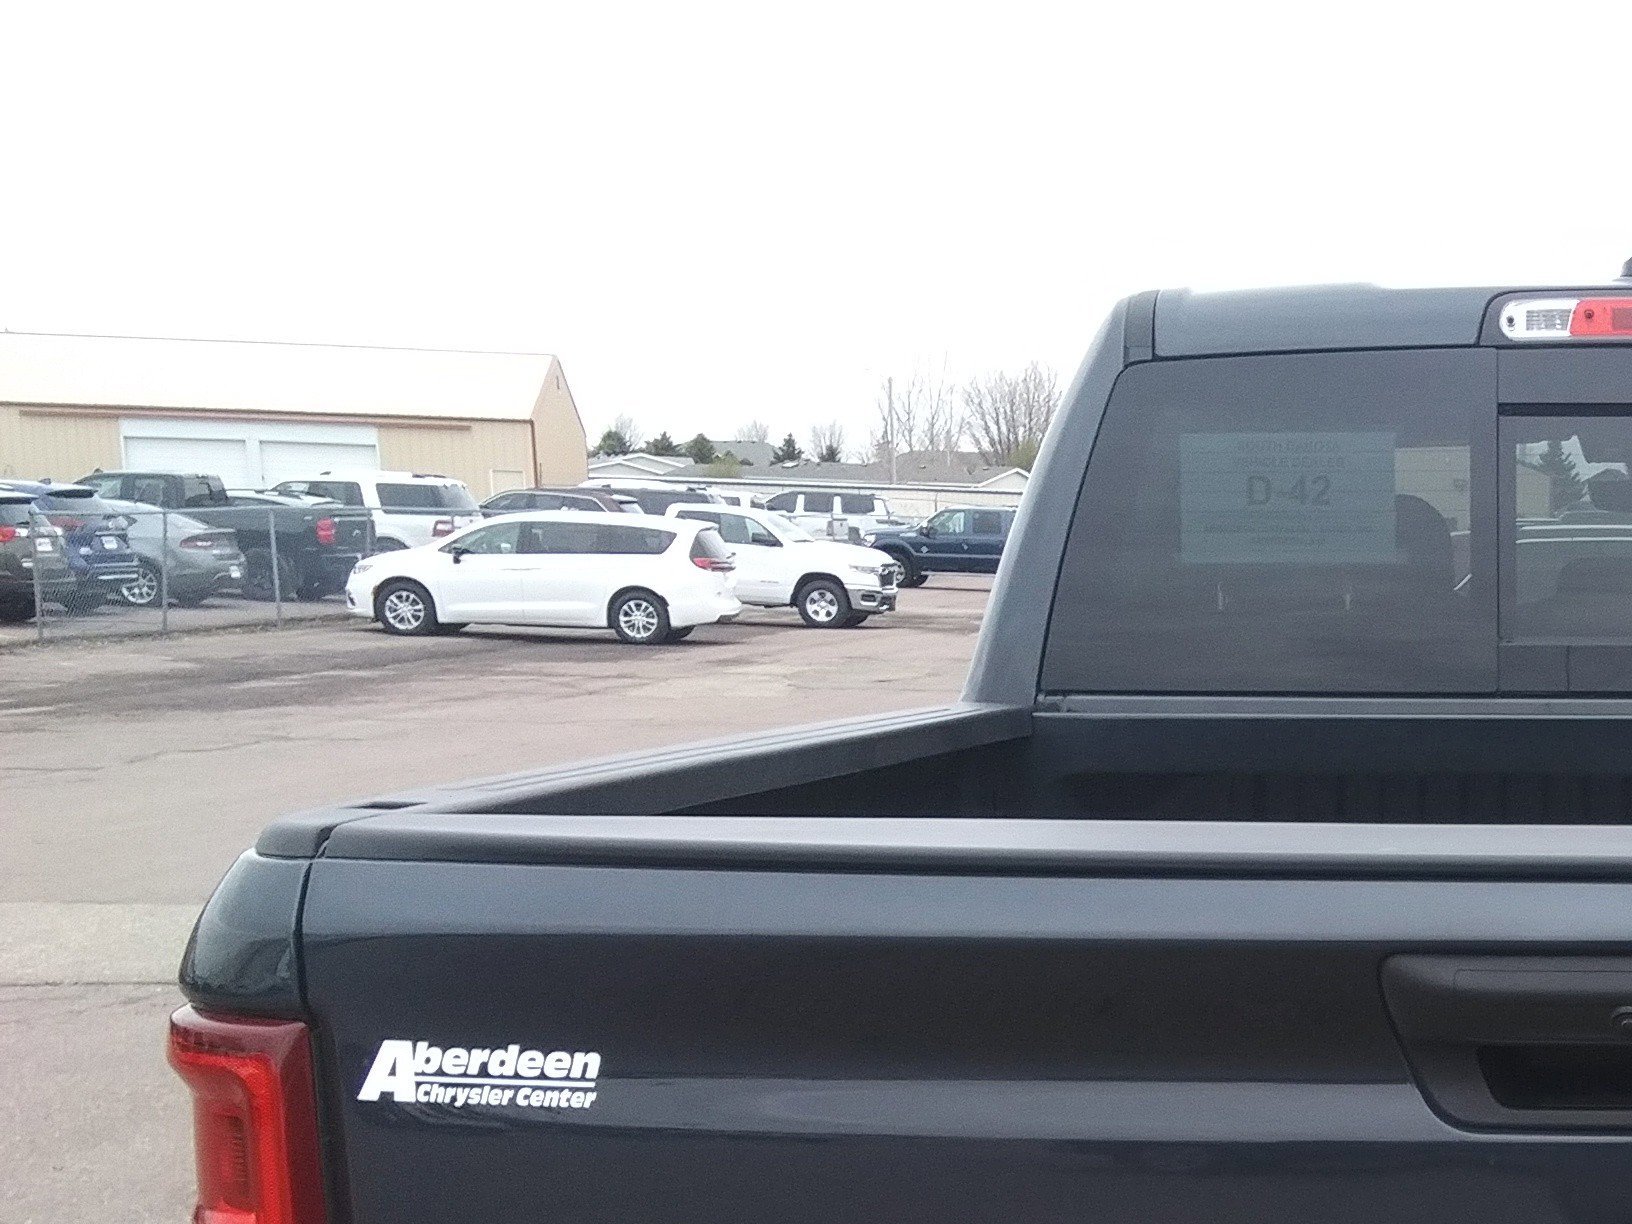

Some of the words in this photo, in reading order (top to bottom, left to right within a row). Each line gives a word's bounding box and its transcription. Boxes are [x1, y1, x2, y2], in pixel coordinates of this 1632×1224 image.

[1246, 474, 1331, 505] D-42
[357, 1039, 601, 1102] Aberdeen
[416, 1083, 513, 1108] Chrysler
[515, 1086, 598, 1108] Center
